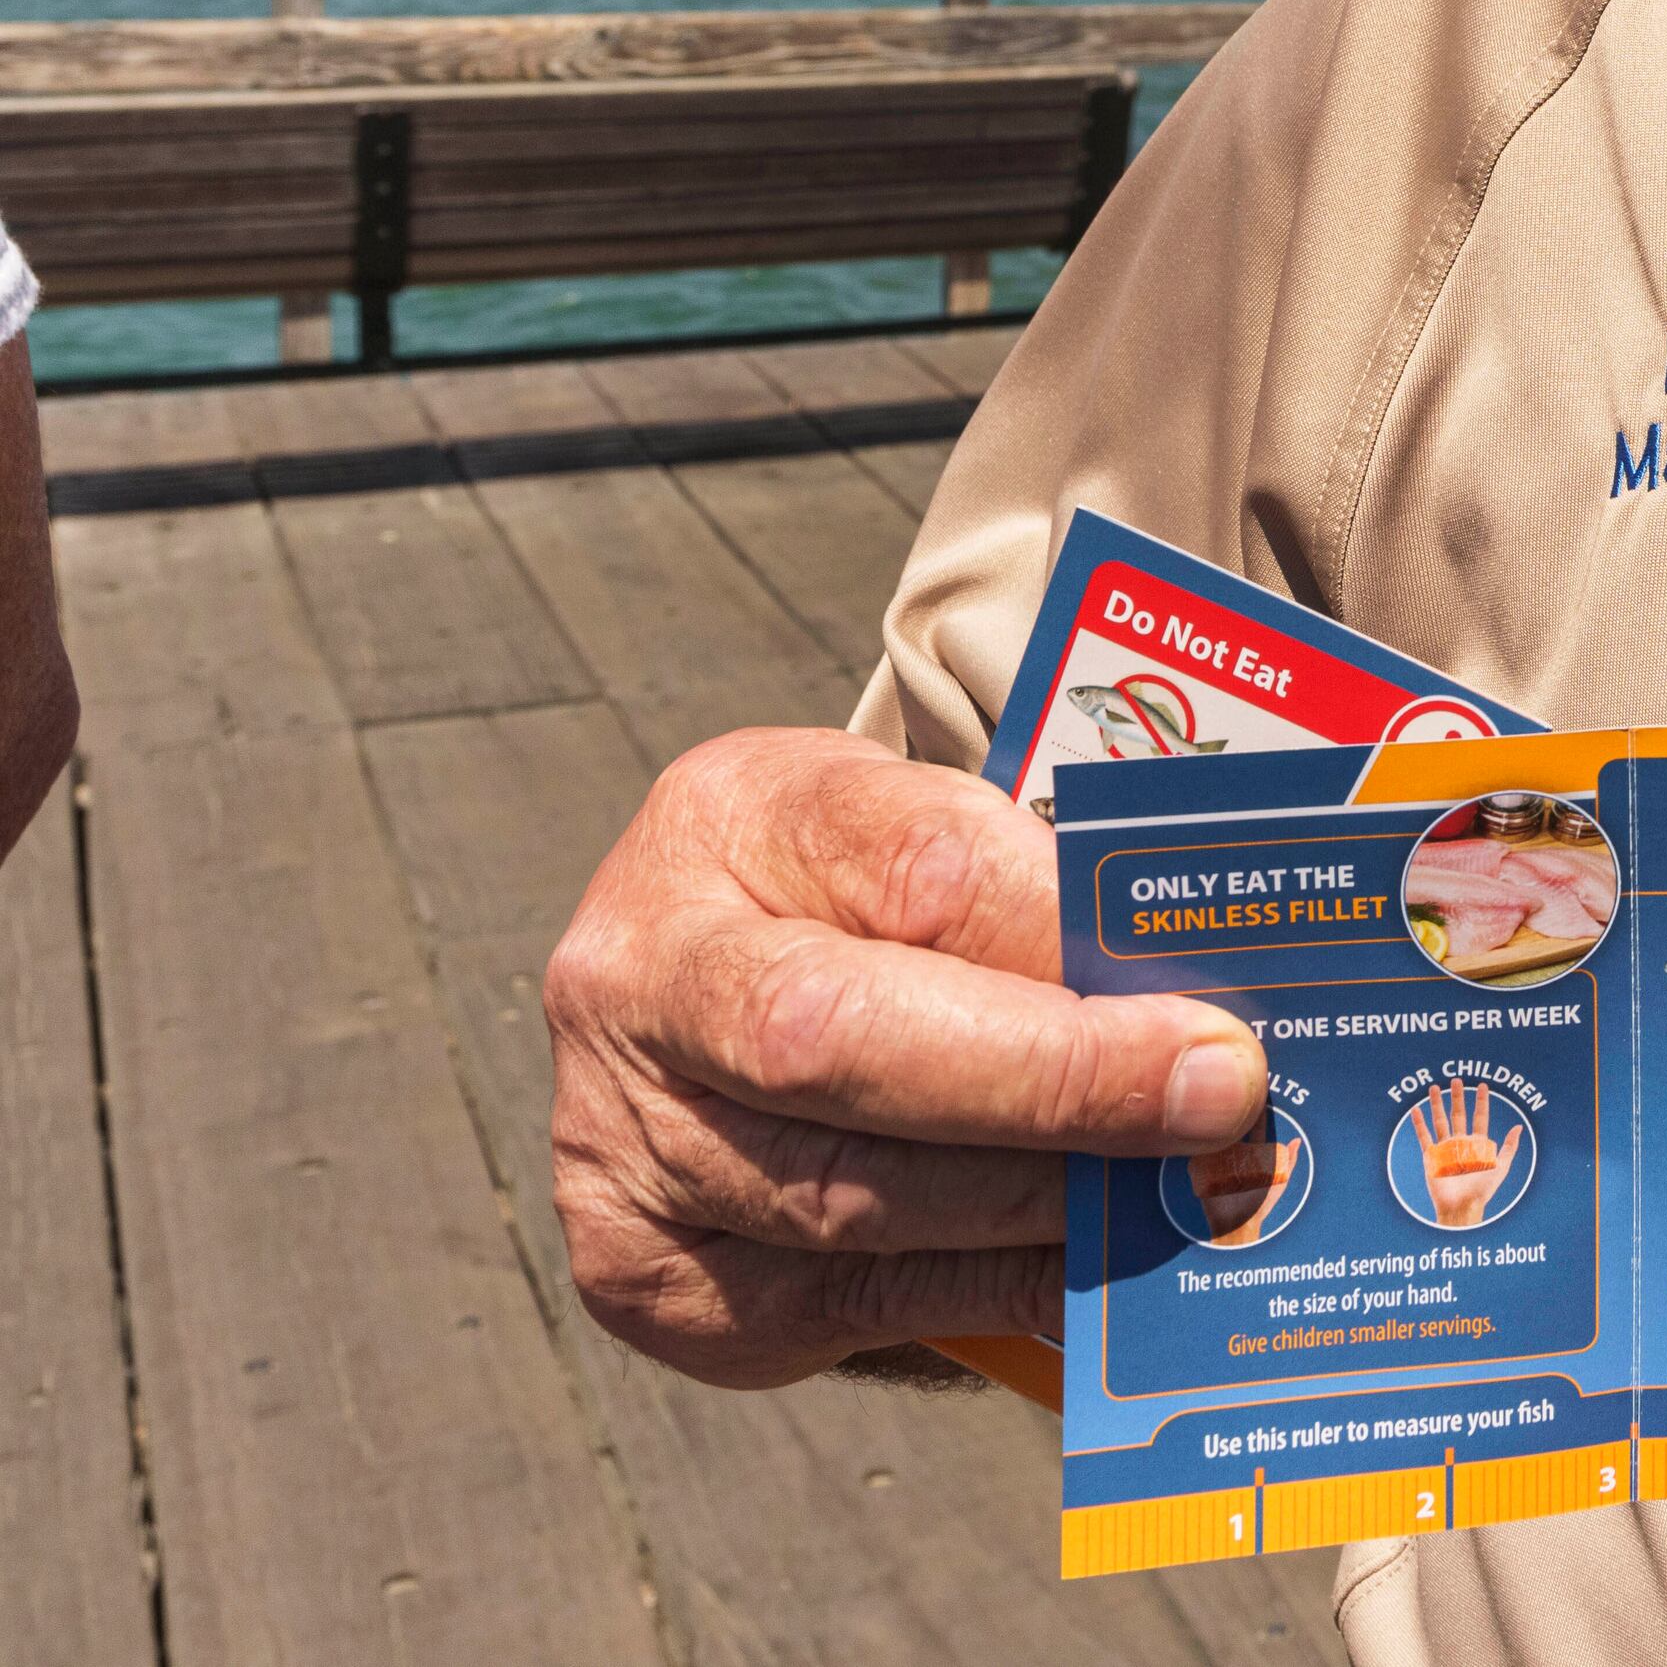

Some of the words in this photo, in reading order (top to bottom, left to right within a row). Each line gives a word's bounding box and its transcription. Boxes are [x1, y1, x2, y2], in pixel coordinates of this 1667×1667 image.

[1103, 589, 1155, 634] Do
[1161, 614, 1228, 670] Not
[1232, 648, 1293, 698] Eat
[1130, 873, 1219, 902] ONLY
[1227, 868, 1287, 895] EAT
[1293, 864, 1355, 890] THE
[1132, 902, 1281, 935] SKINLESS
[1289, 895, 1388, 923] FILLET
[1273, 1017, 1329, 1039] ONE
[1335, 1011, 1448, 1037] SERVING
[1455, 1009, 1503, 1031] PER
[1508, 1004, 1581, 1028] WEEK
[1387, 1068, 1434, 1103] FOR
[1442, 1059, 1548, 1112] CHILDREN
[1177, 1270, 1212, 1294] The
[1215, 1255, 1346, 1287] recommended
[1350, 1252, 1415, 1278] serving
[1419, 1247, 1439, 1271] of
[1440, 1246, 1473, 1269] fish
[1477, 1245, 1491, 1267] is
[1494, 1242, 1546, 1265] about
[1268, 1294, 1300, 1318] the
[1303, 1292, 1337, 1315] size
[1340, 1287, 1361, 1311] of
[1363, 1289, 1404, 1315] your
[1407, 1280, 1458, 1306] hand.
[1228, 1333, 1268, 1357] Give
[1272, 1325, 1345, 1352] children
[1349, 1318, 1416, 1344] smaller
[1419, 1314, 1496, 1339] servings.
[1204, 1433, 1242, 1459] Use
[1246, 1426, 1287, 1454] this
[1291, 1421, 1343, 1449] ruler
[1346, 1421, 1369, 1442] to
[1373, 1413, 1463, 1440] measure
[1466, 1408, 1514, 1437] your
[1517, 1398, 1555, 1425] fish
[1228, 1513, 1242, 1540] 1
[1416, 1491, 1435, 1518] 2
[1598, 1466, 1616, 1493] 3
